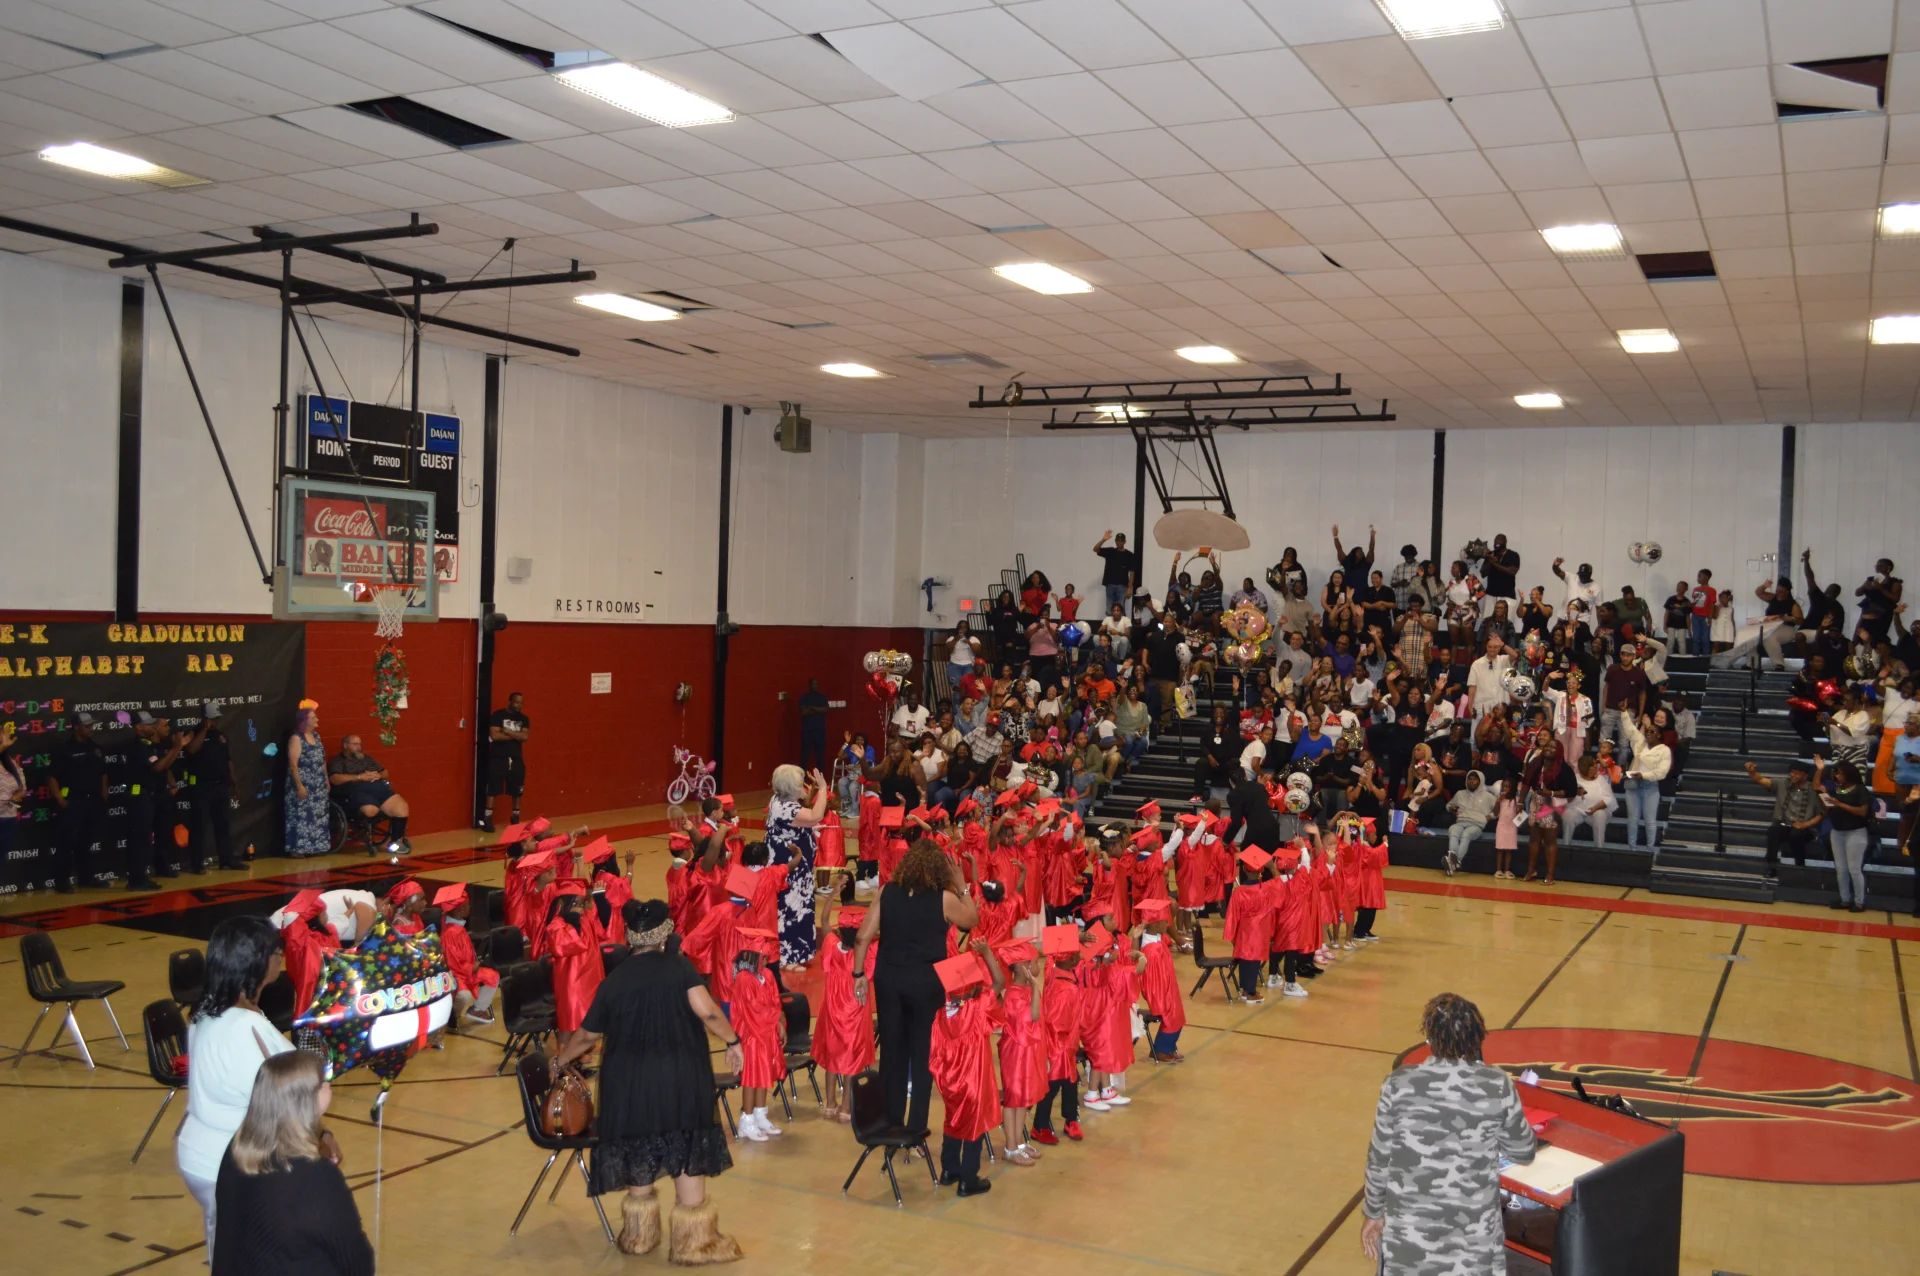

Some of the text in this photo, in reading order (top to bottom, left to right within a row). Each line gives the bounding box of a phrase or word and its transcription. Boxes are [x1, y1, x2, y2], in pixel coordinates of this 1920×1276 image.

[314, 410, 343, 425] DASNI
[430, 427, 456, 441] DASANI
[373, 454, 401, 468] PERIOD
[420, 452, 454, 471] GUEST
[314, 507, 379, 537] Coca-Cola
[341, 543, 428, 567] BAKER
[556, 599, 641, 614] RESTROOMS
[108, 624, 245, 643] GRADUATION
[0, 653, 234, 677] ALPHABET RAP
[74, 701, 143, 712] KINDERGARTEN
[149, 699, 168, 709] WILL
[171, 699, 182, 708] BE
[184, 697, 200, 707] THE
[229, 696, 245, 705] FOR
[247, 694, 263, 704] ME!
[7, 848, 39, 860] FINISH
